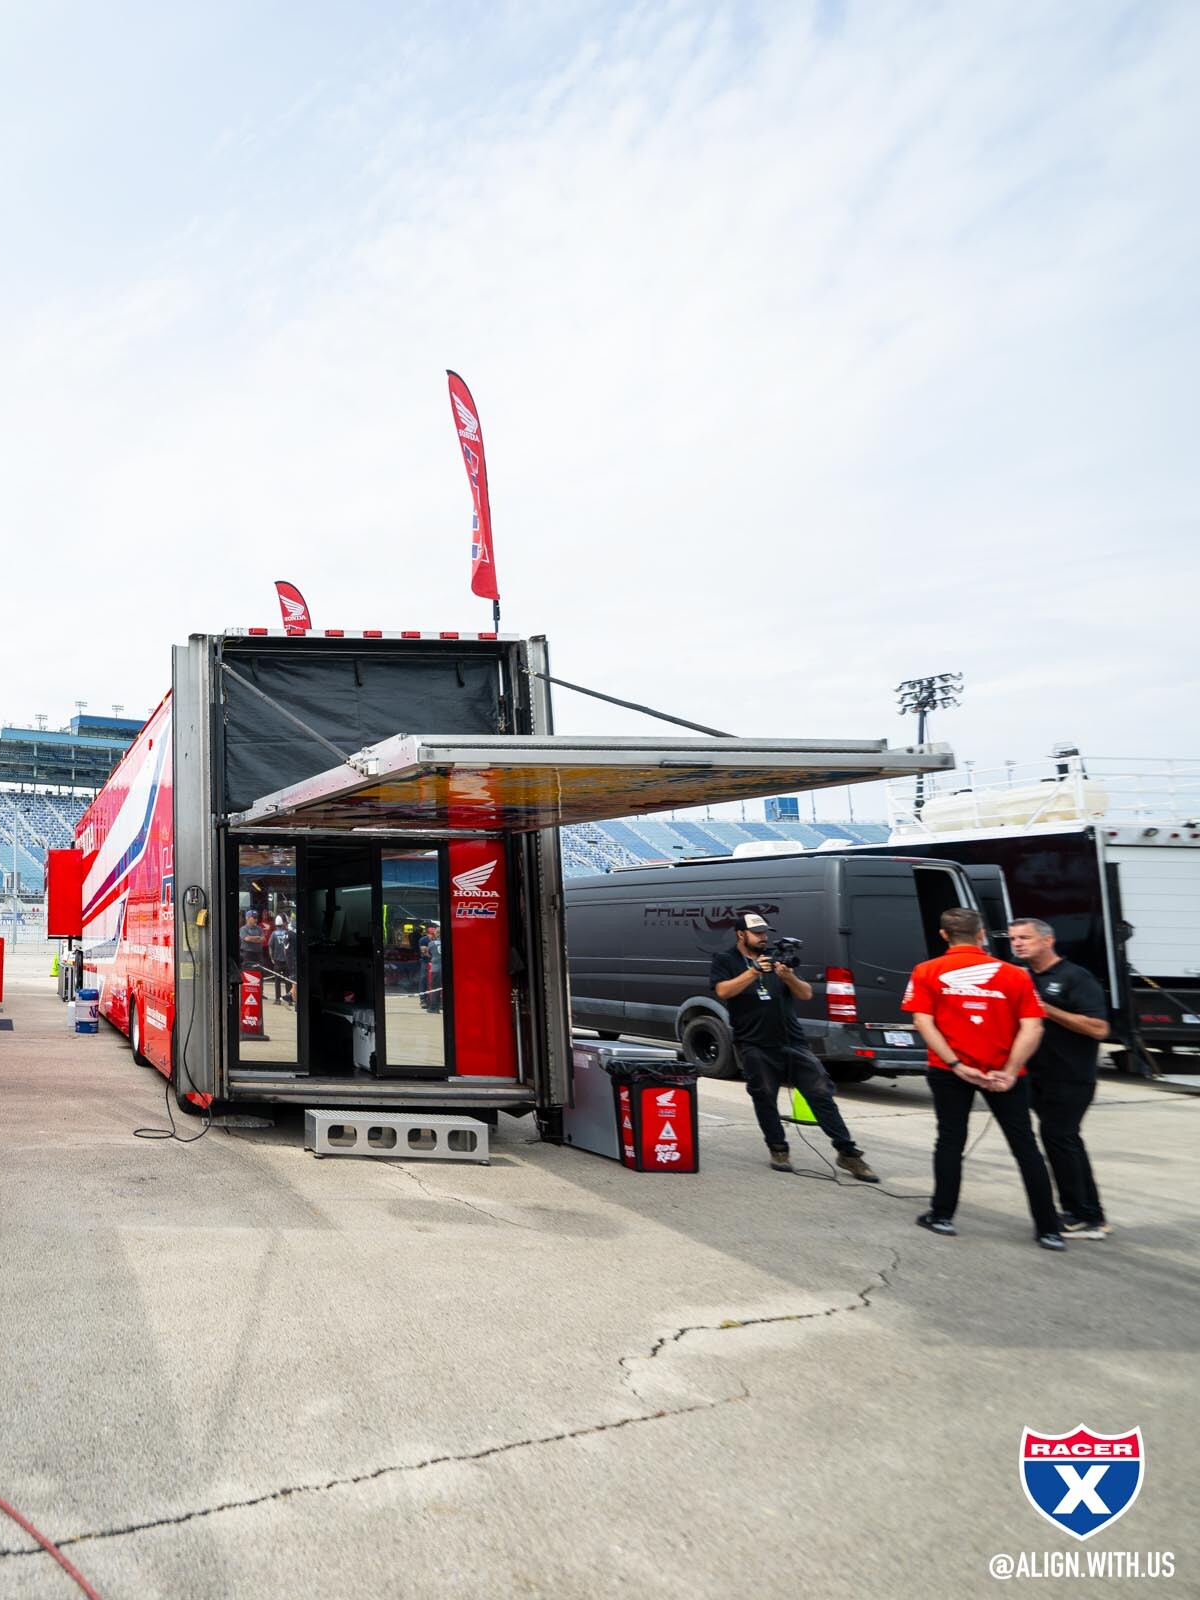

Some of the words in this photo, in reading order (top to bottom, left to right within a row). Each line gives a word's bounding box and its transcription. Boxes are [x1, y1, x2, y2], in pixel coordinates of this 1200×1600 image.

[459, 429, 481, 443] HONDA
[283, 614, 307, 622] HONDA
[455, 901, 499, 916] HRC
[656, 1151, 681, 1163] RED
